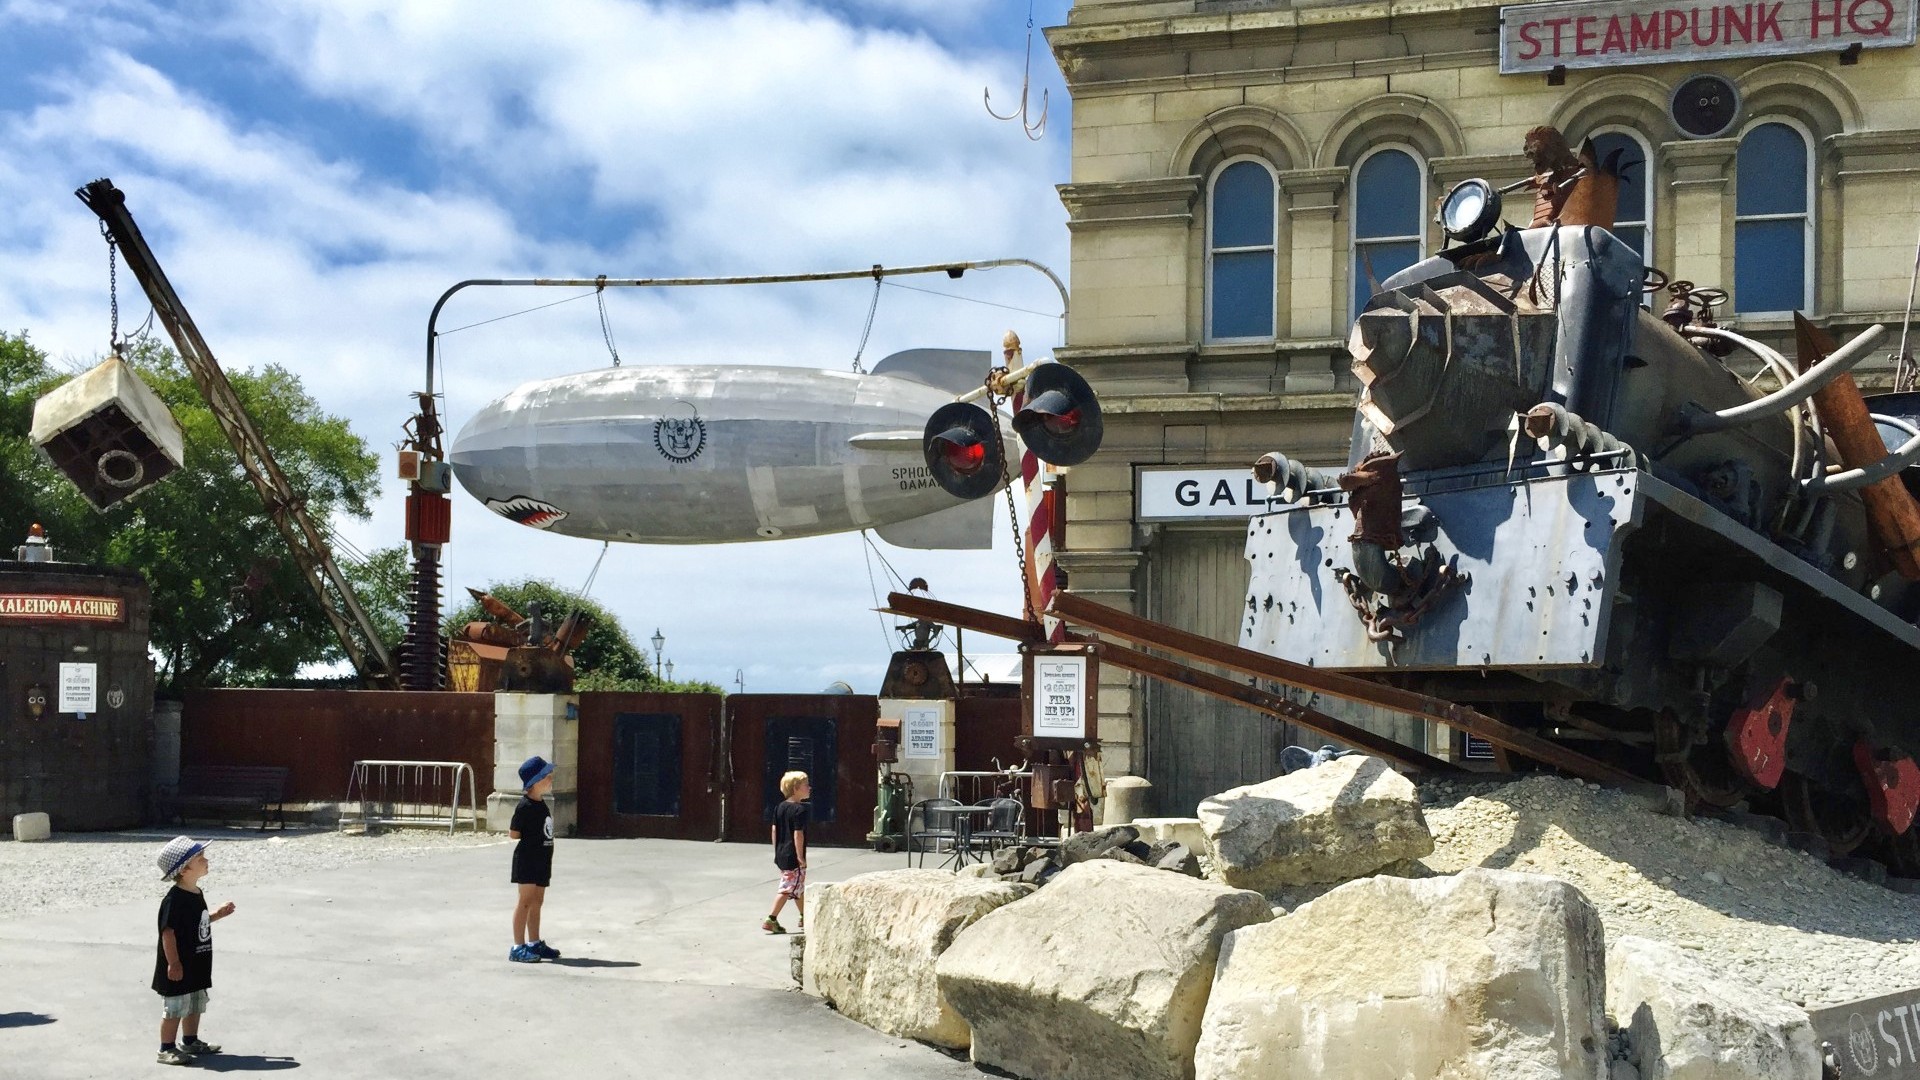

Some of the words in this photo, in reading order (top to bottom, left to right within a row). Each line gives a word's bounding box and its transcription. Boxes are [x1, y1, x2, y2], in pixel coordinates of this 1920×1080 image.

[1518, 1, 1785, 60] STEAMPUNK
[1811, 0, 1894, 39] HQ
[900, 478, 941, 490] OAMA
[1175, 479, 1297, 507] GAL
[0, 599, 118, 616] KALEIDOMACHINE
[1049, 695, 1071, 704] FIRE
[1045, 706, 1057, 715] ME
[1059, 706, 1075, 716] UP!
